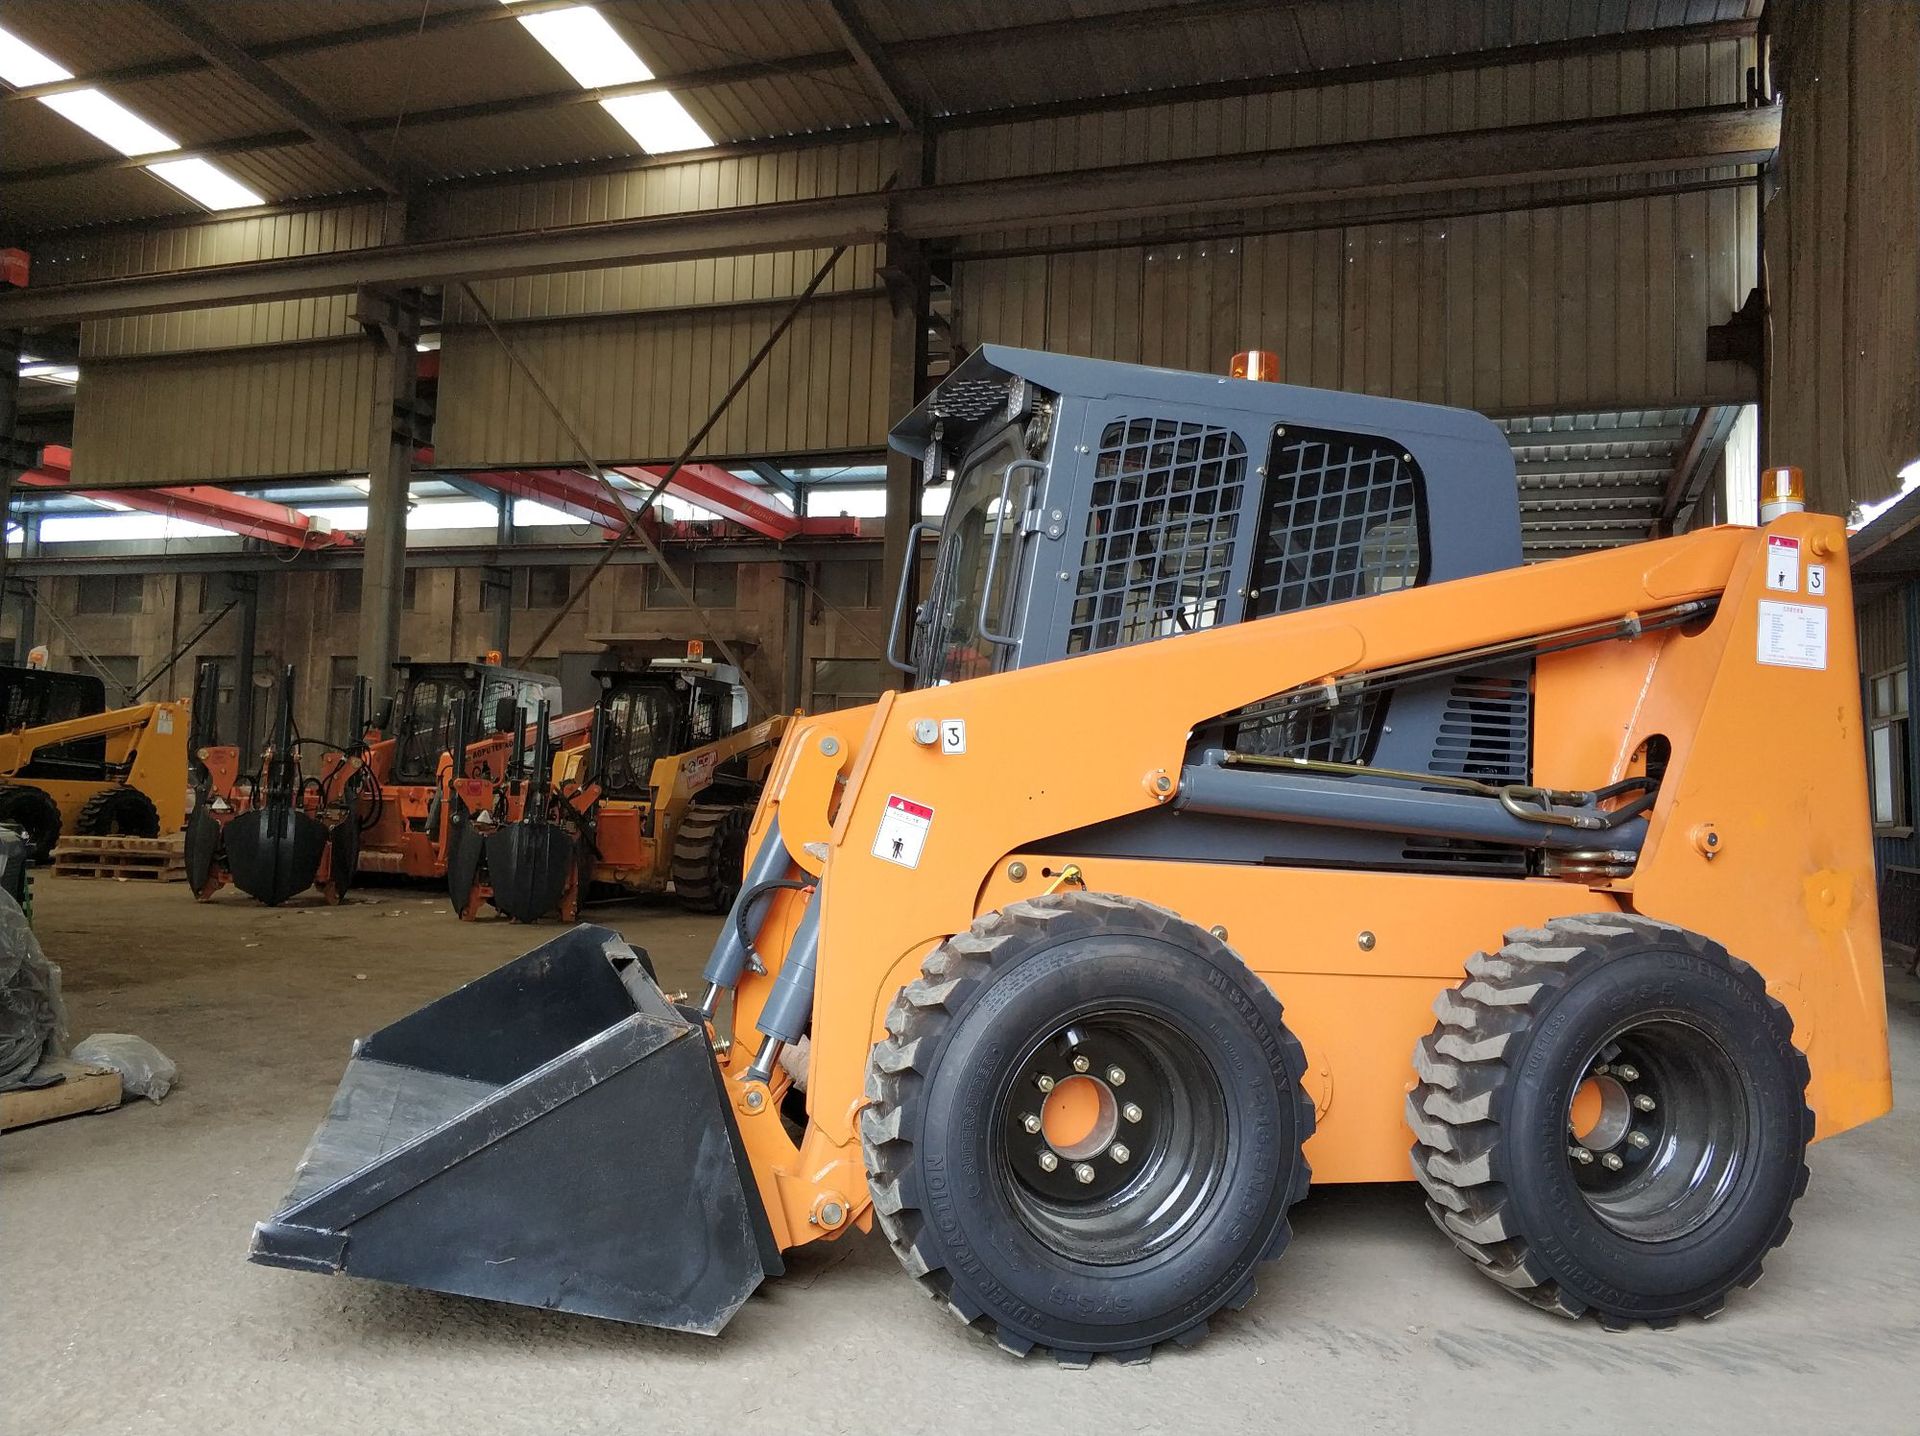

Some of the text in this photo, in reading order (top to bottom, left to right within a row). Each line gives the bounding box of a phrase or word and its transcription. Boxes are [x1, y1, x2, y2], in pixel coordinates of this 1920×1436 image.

[1208, 969, 1290, 1093] HI STABILITY
[1525, 1012, 1566, 1077] TUBELESS
[925, 1153, 982, 1279] TRACTION
